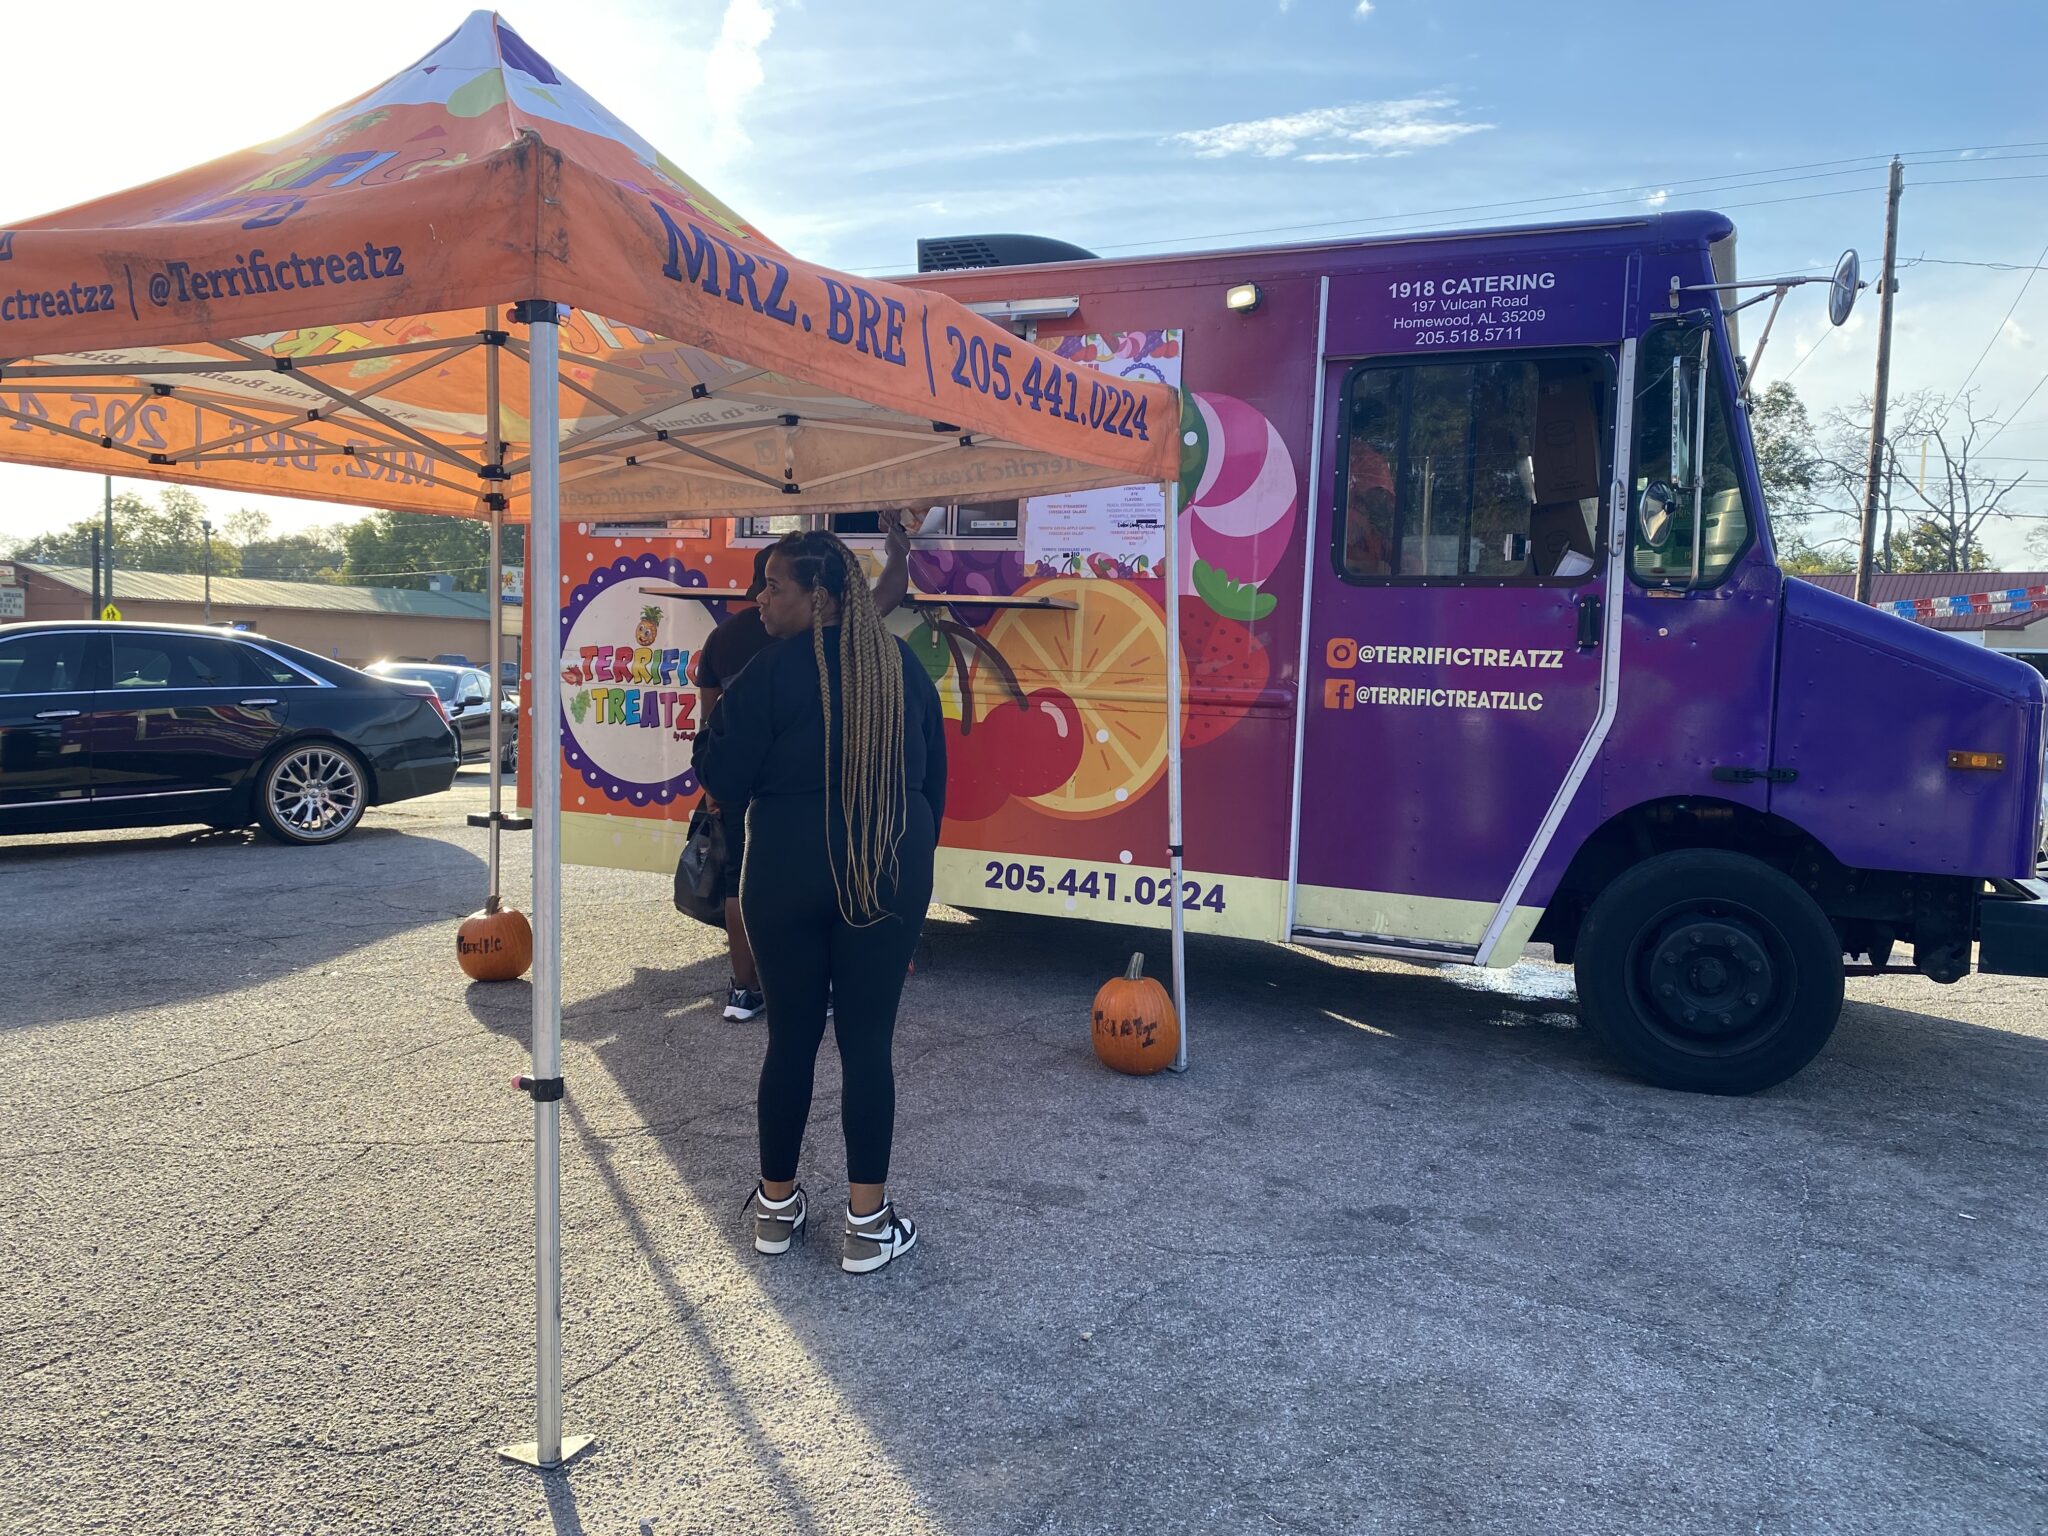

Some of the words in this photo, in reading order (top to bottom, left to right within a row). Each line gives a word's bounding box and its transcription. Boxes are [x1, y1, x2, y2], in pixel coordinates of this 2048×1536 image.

[148, 242, 405, 307] @Terrifictreatz
[1388, 281, 1435, 299] 1918
[1441, 272, 1556, 296] CATERING
[1411, 300, 1436, 313] 197
[1440, 297, 1488, 312] Vulcan
[1491, 294, 1529, 309] Road
[651, 202, 812, 333] MRZ.
[823, 276, 906, 367] BRE
[947, 325, 1150, 442] 205.441.0224
[1393, 313, 1474, 330] Homewood,
[1477, 311, 1497, 325] AL
[1500, 308, 1546, 324] 35209
[1414, 327, 1522, 346] 205.518.5711
[579, 645, 702, 688] TERRIFIC
[1358, 645, 1564, 669] @TERRIFICTREATZZ
[591, 687, 697, 730] TREATZ
[1356, 686, 1543, 711] @TERRIFICTREATZLLC
[984, 860, 1226, 914] 205.441.0224
